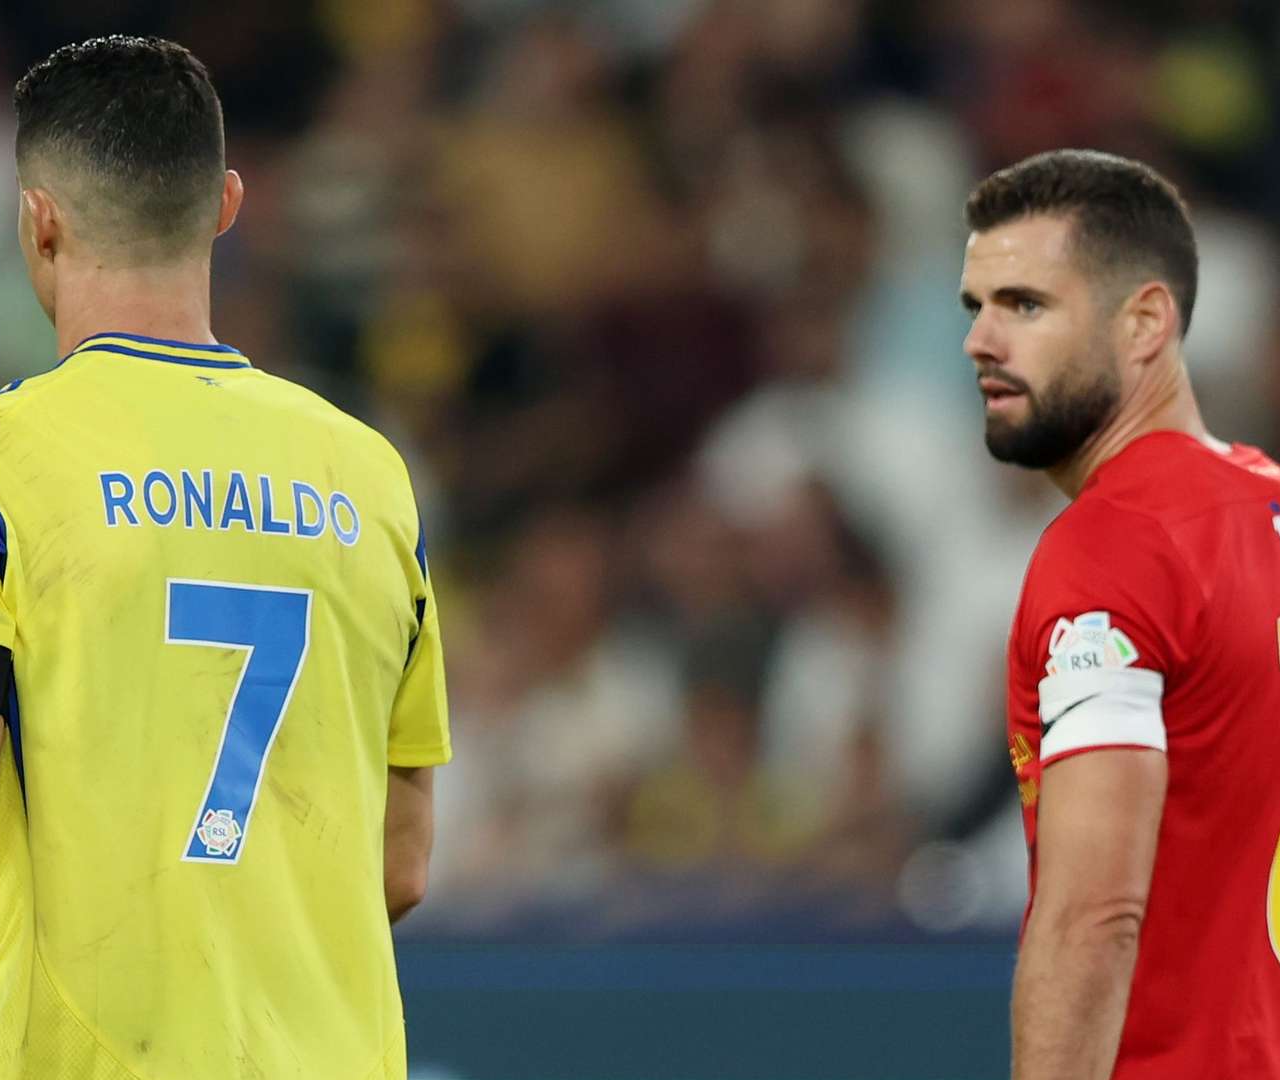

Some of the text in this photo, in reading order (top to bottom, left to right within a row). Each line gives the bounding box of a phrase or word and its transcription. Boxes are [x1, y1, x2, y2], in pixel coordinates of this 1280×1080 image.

[98, 468, 362, 547] RONALDO
[1070, 651, 1103, 671] RSL
[165, 577, 314, 865] 7
[212, 827, 227, 837] RSL
